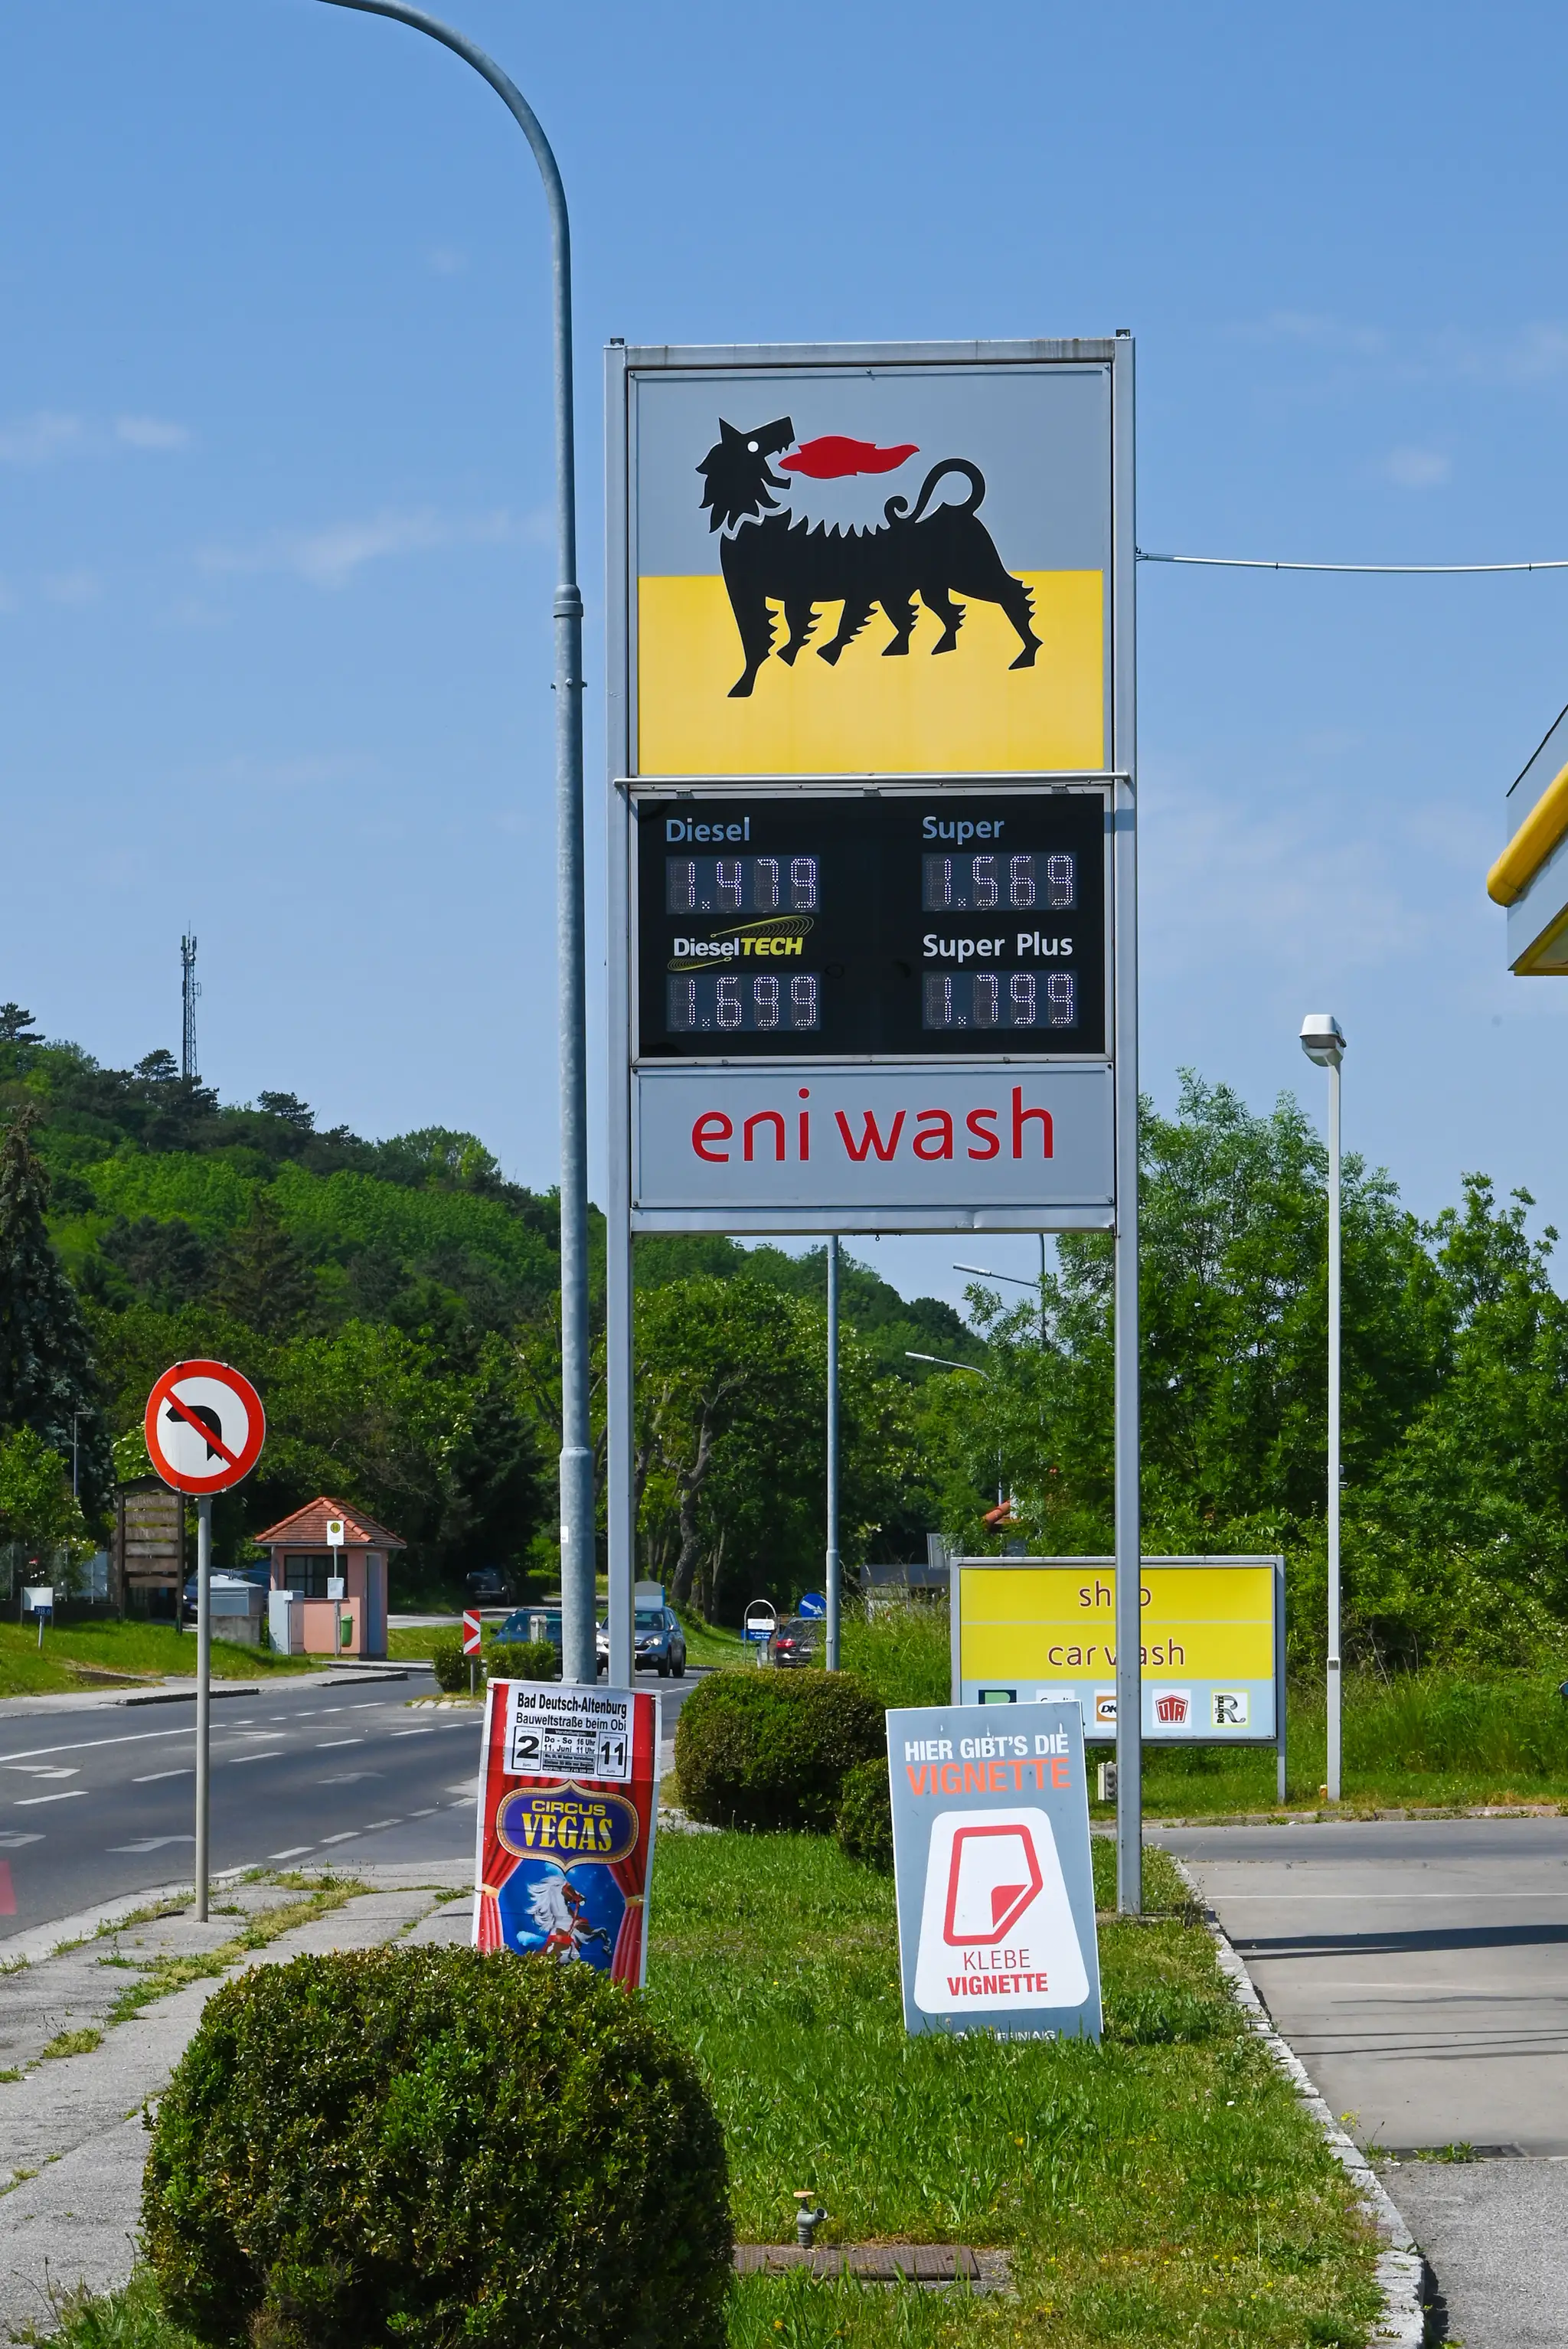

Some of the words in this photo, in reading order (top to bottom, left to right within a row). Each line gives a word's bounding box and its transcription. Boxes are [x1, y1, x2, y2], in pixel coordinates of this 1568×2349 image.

[666, 817, 750, 842] Diesel
[922, 816, 1004, 845] Super
[688, 857, 817, 910] 1.479
[943, 855, 1073, 907] 1.569
[923, 933, 1005, 962] Super
[1017, 932, 1073, 956] Plus
[688, 975, 817, 1027] 1.699
[943, 973, 1073, 1024] 1.799
[691, 1087, 810, 1163] eni
[834, 1086, 1054, 1162] wash
[1079, 1580, 1152, 1607] sh
[518, 1692, 536, 1709] Bad
[539, 1694, 627, 1720] Deutsch-Altenburg
[1158, 1697, 1186, 1721] UTA
[516, 1712, 583, 1728] Bauweltstraße
[586, 1717, 608, 1730] beim
[611, 1719, 627, 1731] Obi
[516, 1735, 540, 1759] 2
[557, 1745, 572, 1753] Juni
[562, 1736, 573, 1745] So
[601, 1741, 624, 1766] 11
[904, 1739, 953, 1762] HIER
[960, 1735, 1028, 1759] GIBT'S
[1034, 1733, 1069, 1755] DIE
[906, 1758, 1071, 1795] VIGNETTE
[531, 1800, 606, 1817] CIRCUS
[521, 1812, 613, 1852] VEGAS
[963, 1949, 1031, 1971] KLEBE
[947, 1973, 1048, 1996] VIGNETTE
